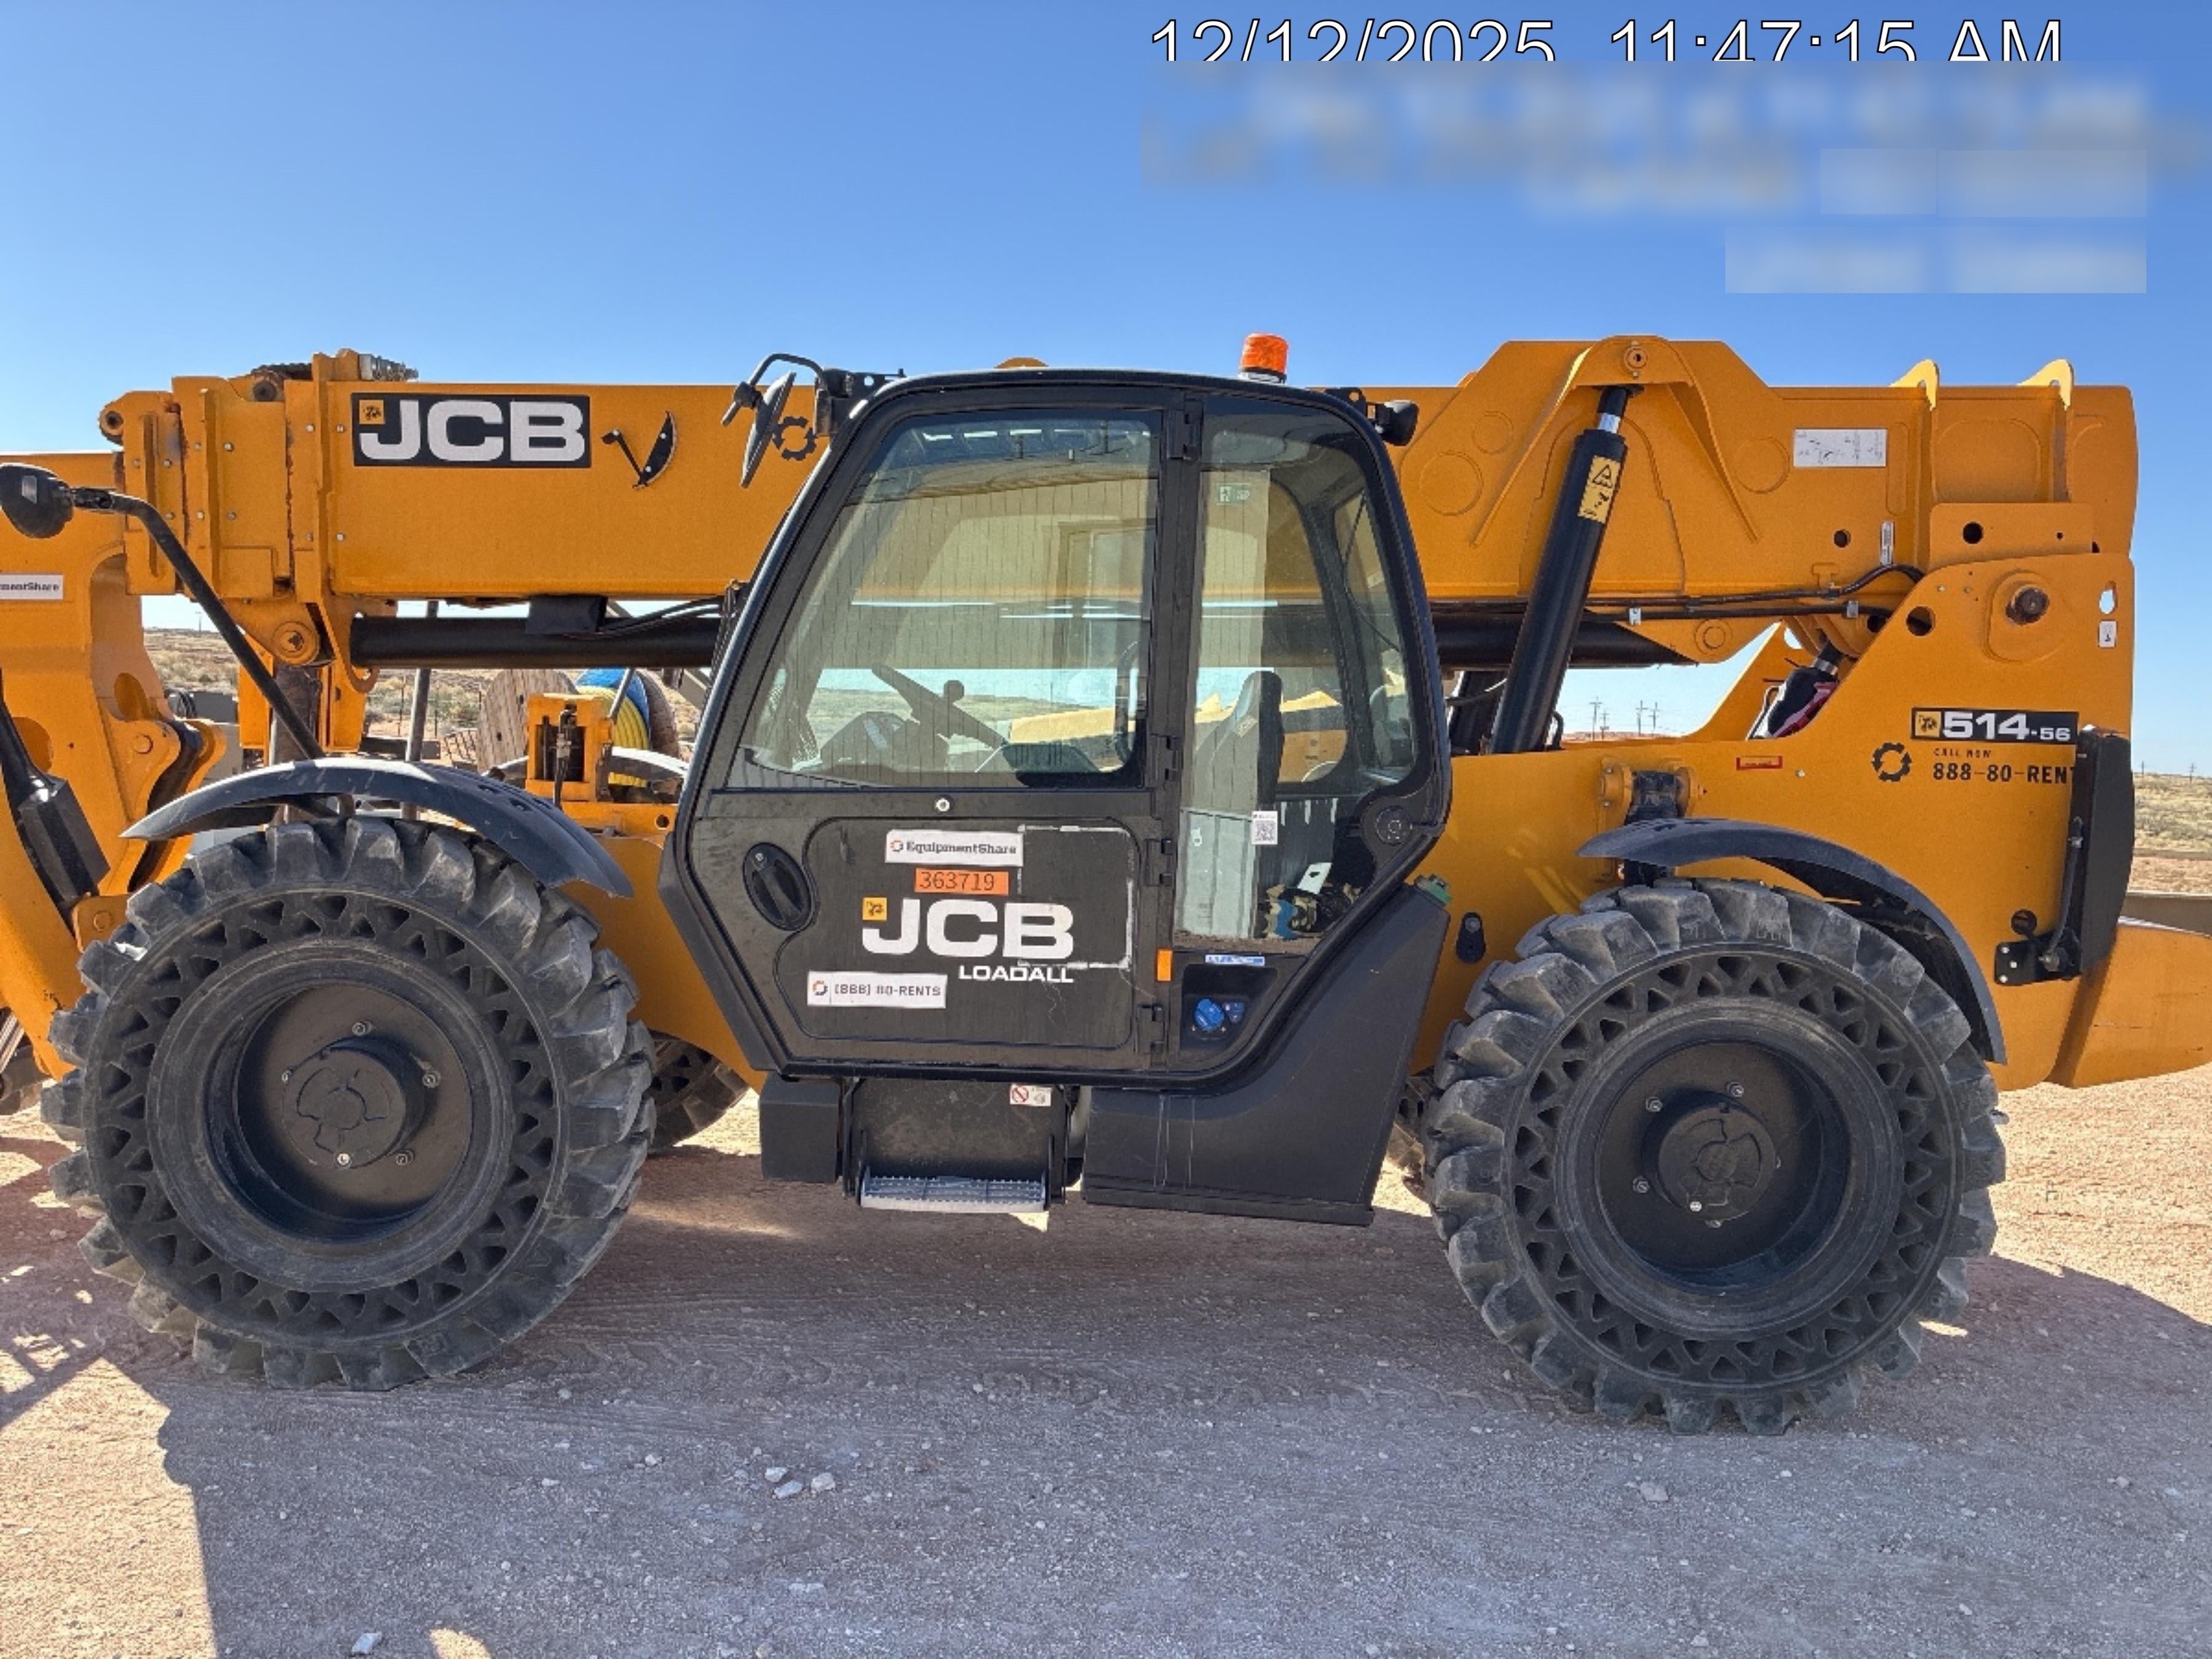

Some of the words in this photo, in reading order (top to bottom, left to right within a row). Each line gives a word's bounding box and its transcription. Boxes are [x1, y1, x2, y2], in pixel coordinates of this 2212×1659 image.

[359, 399, 585, 462] JCB
[1933, 763, 2074, 783] 888-80-REN
[906, 841, 1016, 854] EquipmentShare
[919, 871, 994, 891] 363719
[862, 898, 1074, 959] JCB
[959, 965, 1074, 983] LOADALL
